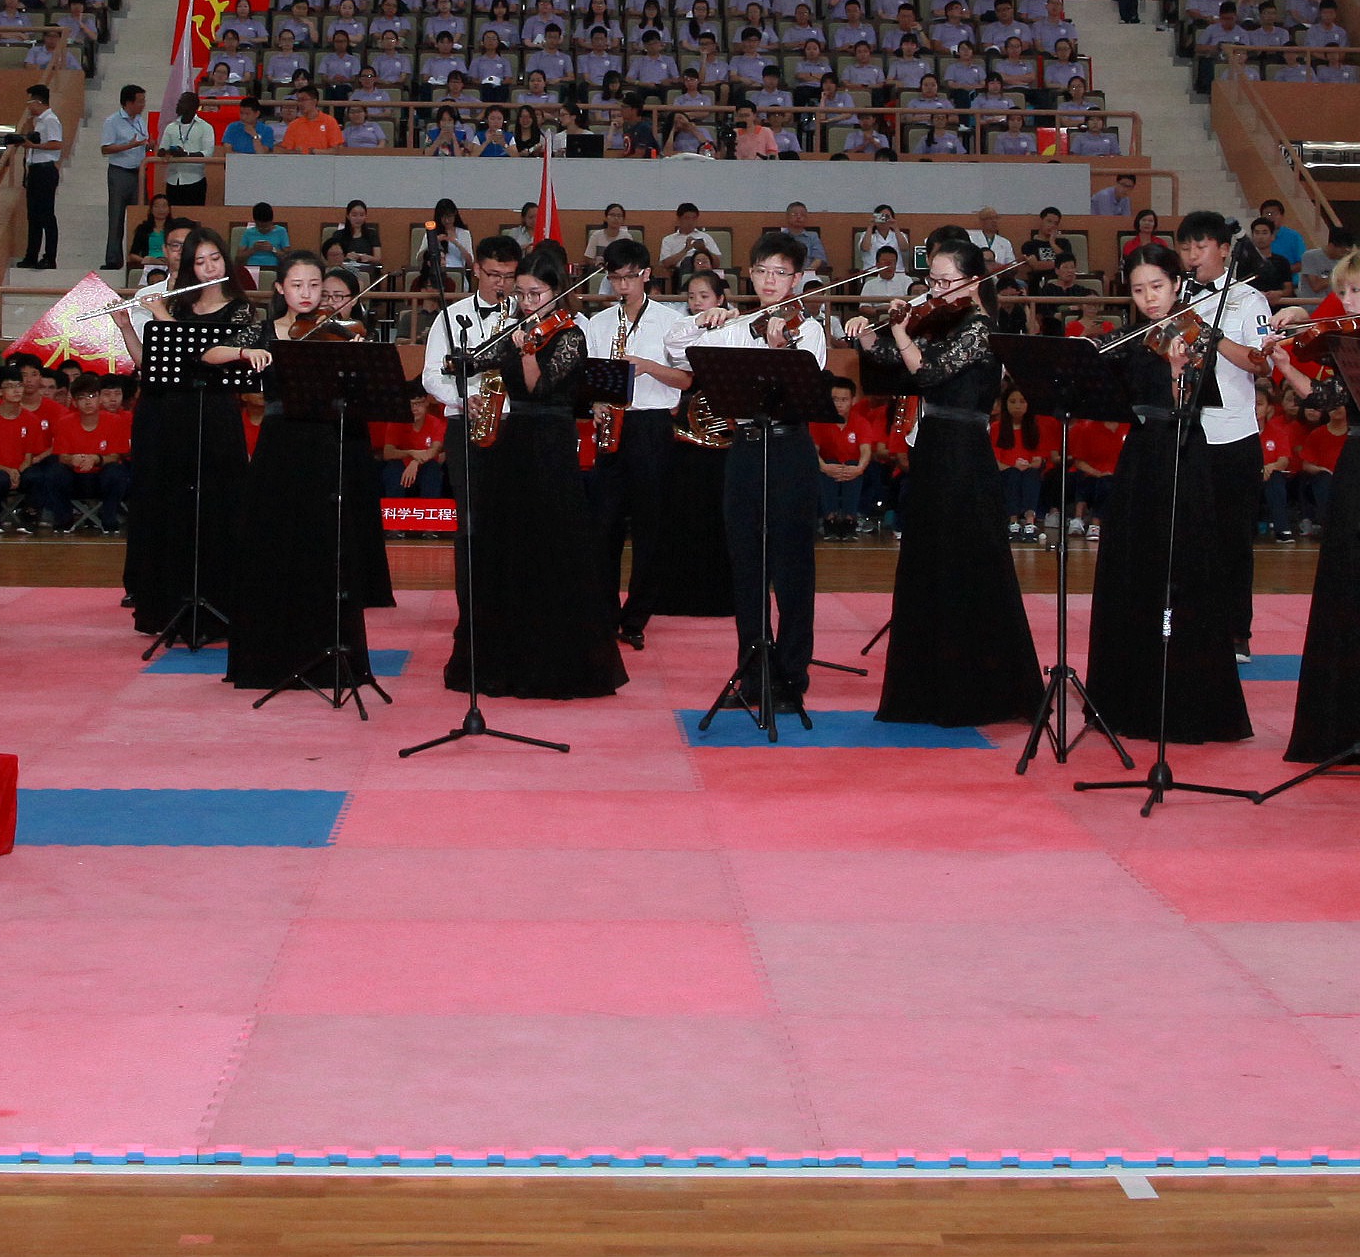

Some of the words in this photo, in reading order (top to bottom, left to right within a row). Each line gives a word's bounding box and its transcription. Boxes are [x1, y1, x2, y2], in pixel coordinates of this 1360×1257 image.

[381, 507, 457, 521] 科学与工程
